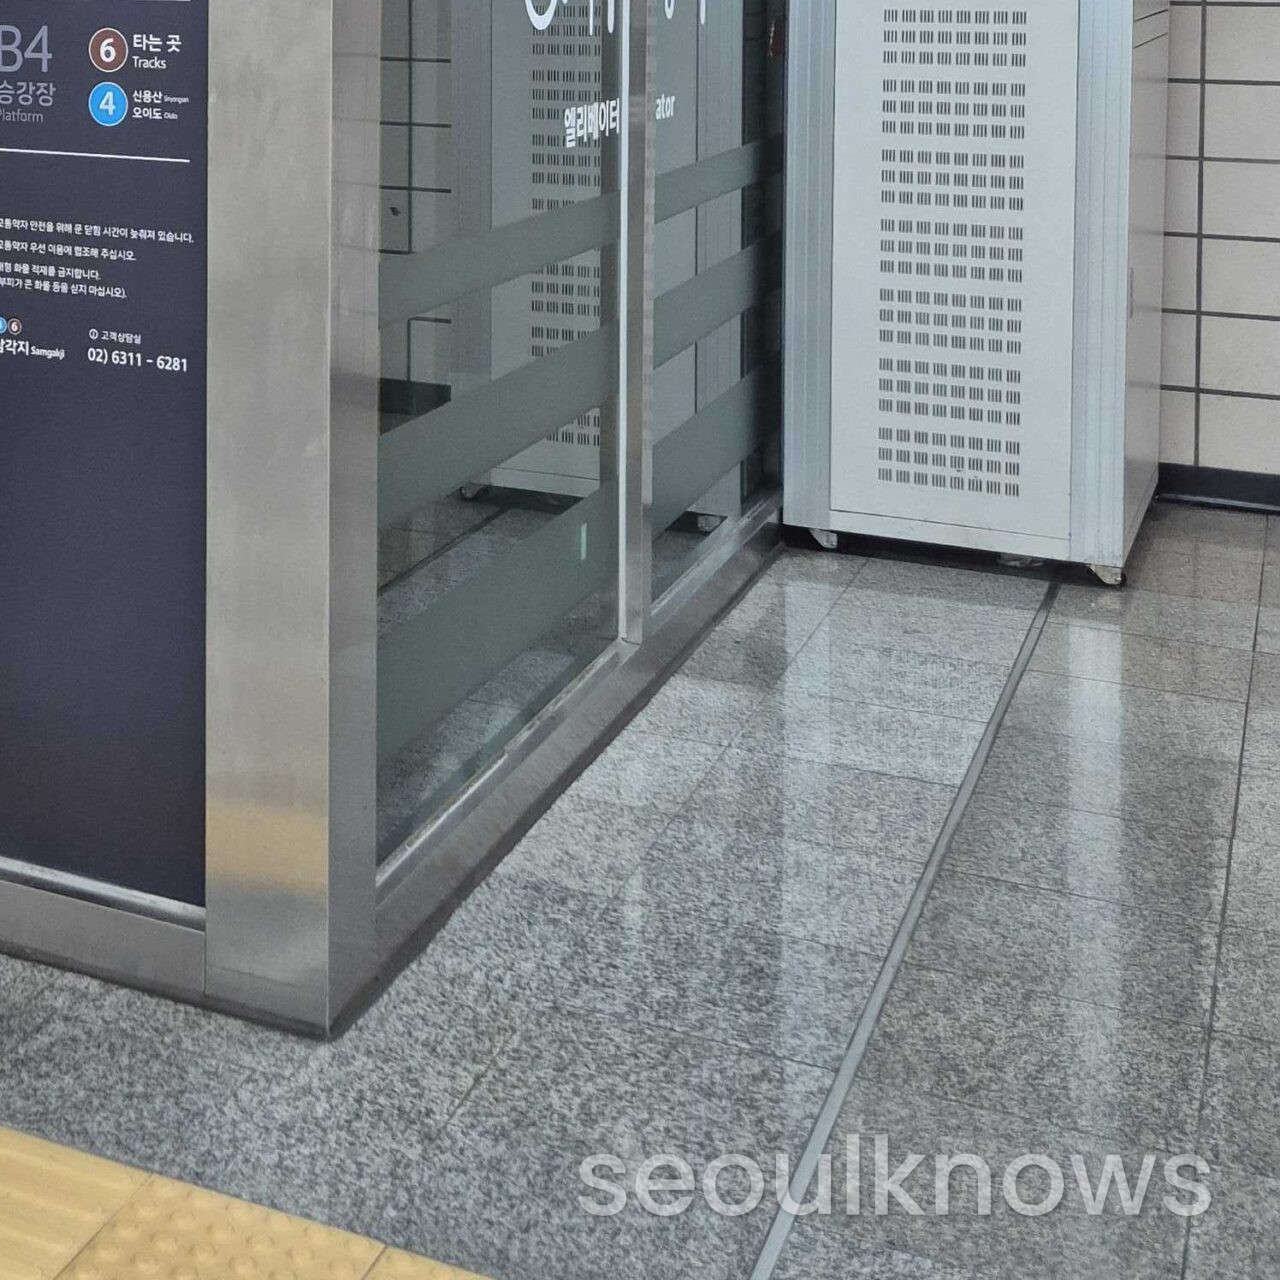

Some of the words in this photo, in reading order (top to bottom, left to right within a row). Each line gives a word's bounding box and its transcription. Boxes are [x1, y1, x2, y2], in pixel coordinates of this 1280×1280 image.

[99, 37, 117, 63] 6
[132, 34, 163, 52] 타는
[166, 34, 182, 53] 곳
[132, 55, 167, 69] Tracks
[99, 90, 116, 116] 4
[132, 90, 163, 103] 신용산
[132, 107, 163, 120] 오이도
[564, 97, 620, 149] 엘리베이터
[29, 220, 54, 233] 안전을
[55, 222, 73, 234] 위해
[74, 223, 83, 235] 문
[84, 224, 101, 237] 닫힘
[102, 225, 129, 239] 시간이
[157, 230, 195, 244] 있습니다.
[29, 242, 46, 254] 우선
[48, 243, 73, 256] 이용에
[57, 266, 101, 280] 금지합니다.
[24, 278, 33, 289] 큰
[52, 280, 68, 293] 등을
[101, 330, 142, 344] 고객상담실
[31, 346, 65, 360] Samgakji
[87, 347, 108, 364] 02)
[111, 351, 142, 367] 6311
[156, 355, 188, 372] 6281
